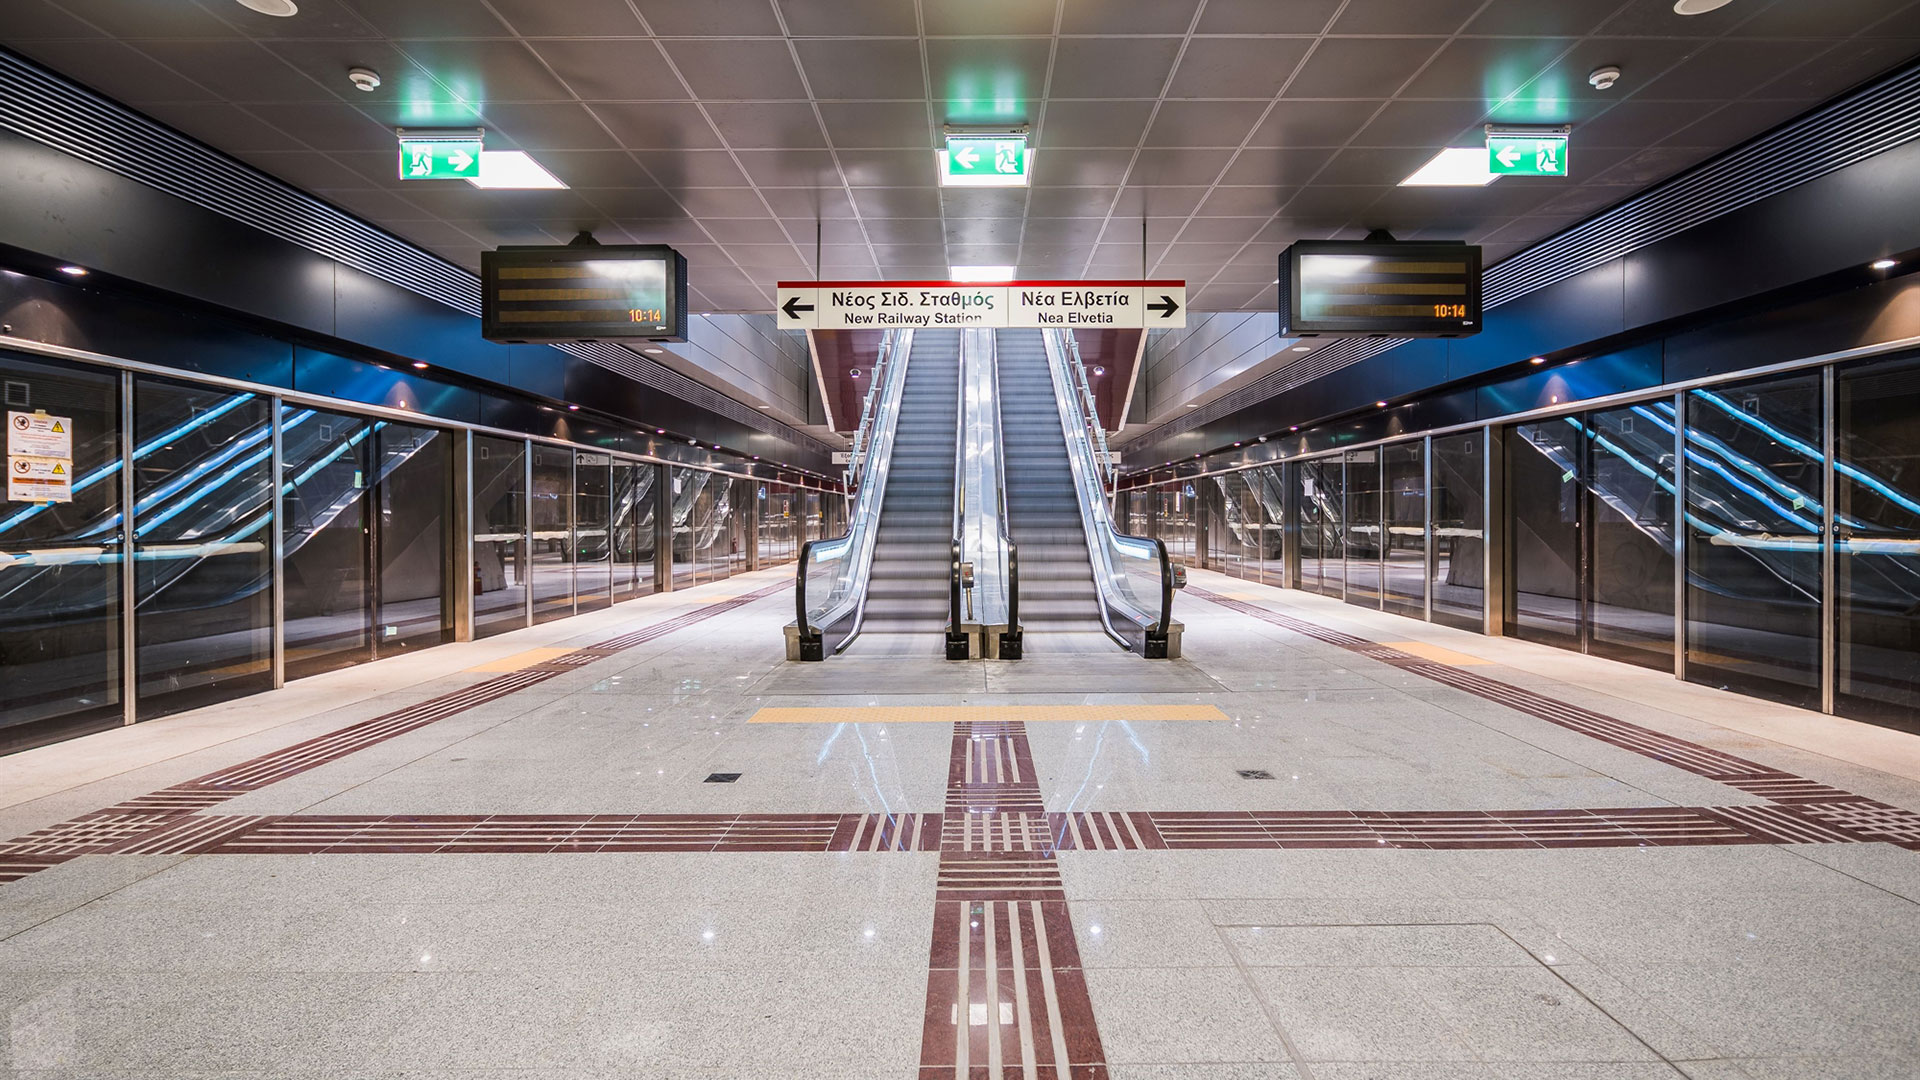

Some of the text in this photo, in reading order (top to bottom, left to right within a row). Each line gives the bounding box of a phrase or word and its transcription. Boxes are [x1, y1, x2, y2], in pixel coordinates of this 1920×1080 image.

[832, 291, 994, 310] Νέος Σιδ. Σταθμός
[1022, 291, 1129, 309] Νέα Ελβετία
[628, 309, 661, 322] 10:14
[1038, 312, 1113, 323] Nea Elvetia
[1433, 304, 1465, 318] 10:14
[845, 313, 982, 327] New Railway Station
